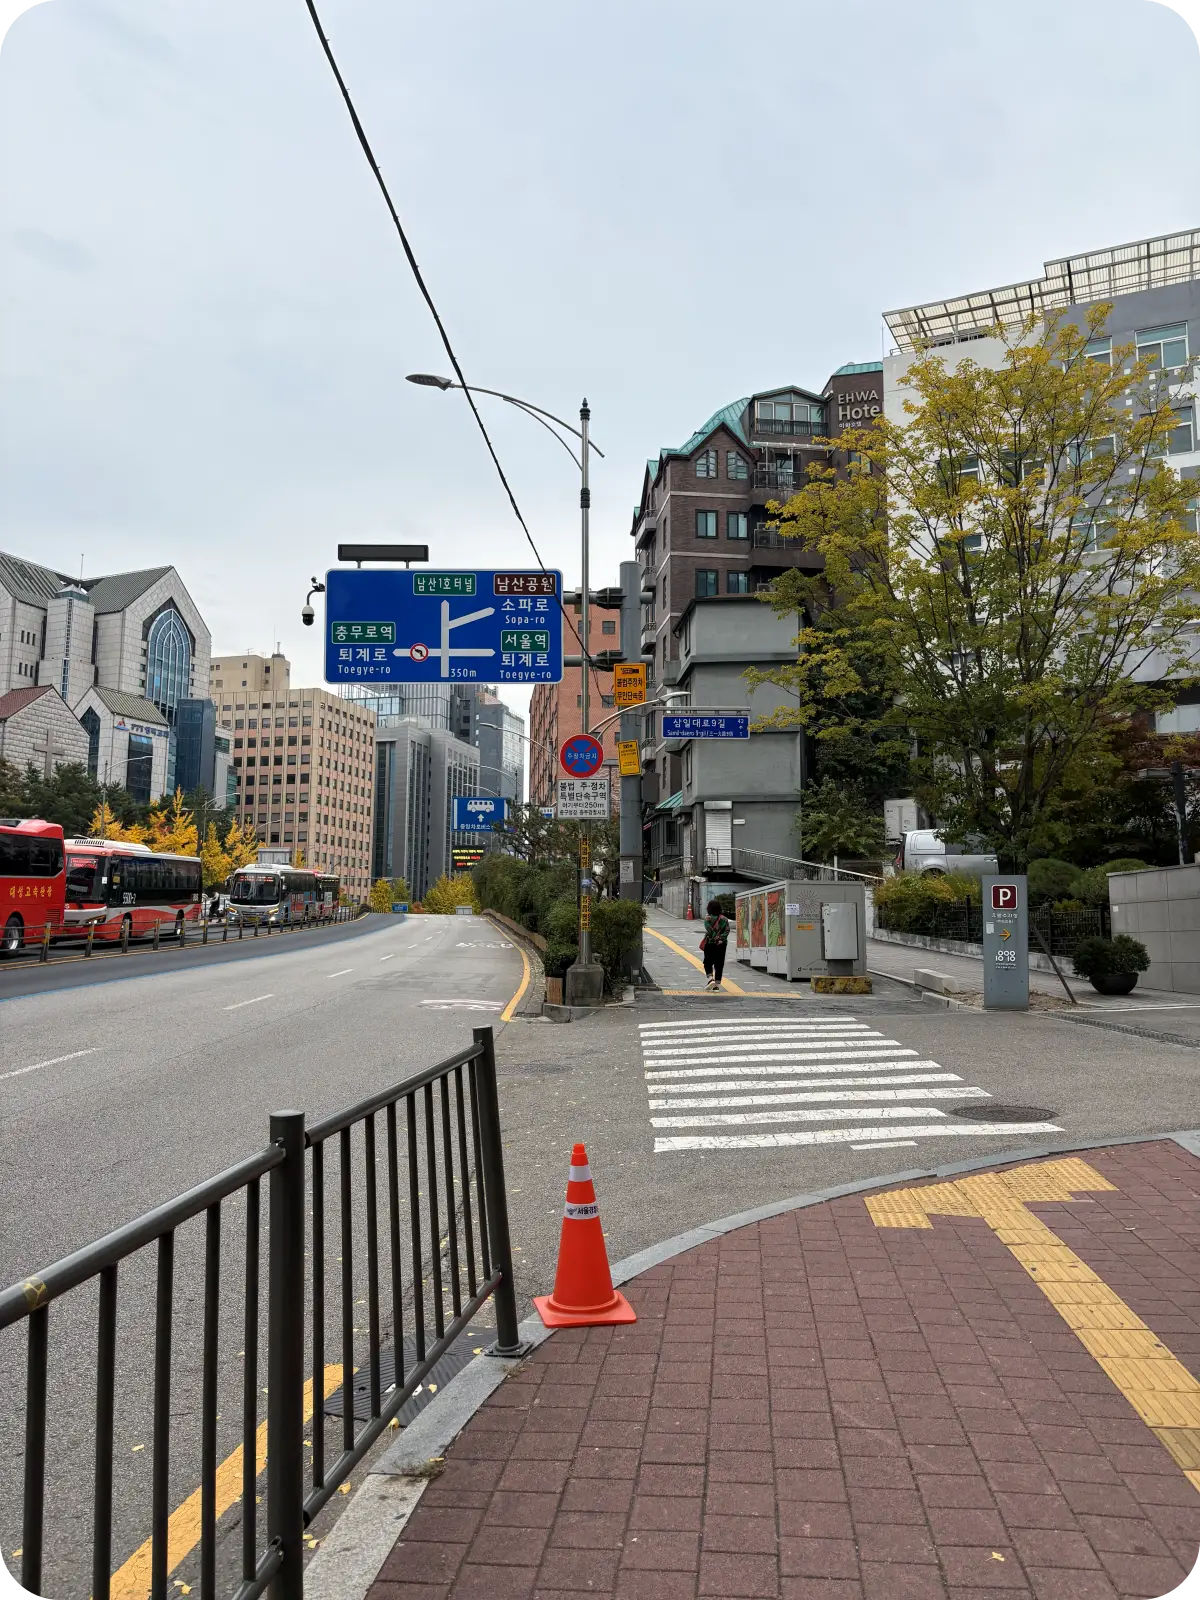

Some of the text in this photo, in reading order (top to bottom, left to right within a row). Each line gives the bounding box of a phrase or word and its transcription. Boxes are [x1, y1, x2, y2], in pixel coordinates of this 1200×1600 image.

[838, 390, 879, 405] EHWA
[417, 577, 472, 593] 남산1호터널
[497, 577, 553, 592] 남산공원
[501, 598, 549, 612] 소파로
[505, 615, 545, 626] Sopa-ro
[335, 625, 392, 640] 충무로역
[505, 633, 546, 649] 서울역
[338, 647, 388, 661] 퇴계로
[501, 653, 549, 667] 퇴계로
[337, 664, 391, 675] Toegye-ro
[450, 668, 477, 678] 350m
[500, 670, 552, 680] Toegye-ro
[560, 782, 575, 792] 불법
[560, 792, 606, 801] 특별단속구역
[999, 888, 1012, 906] P
